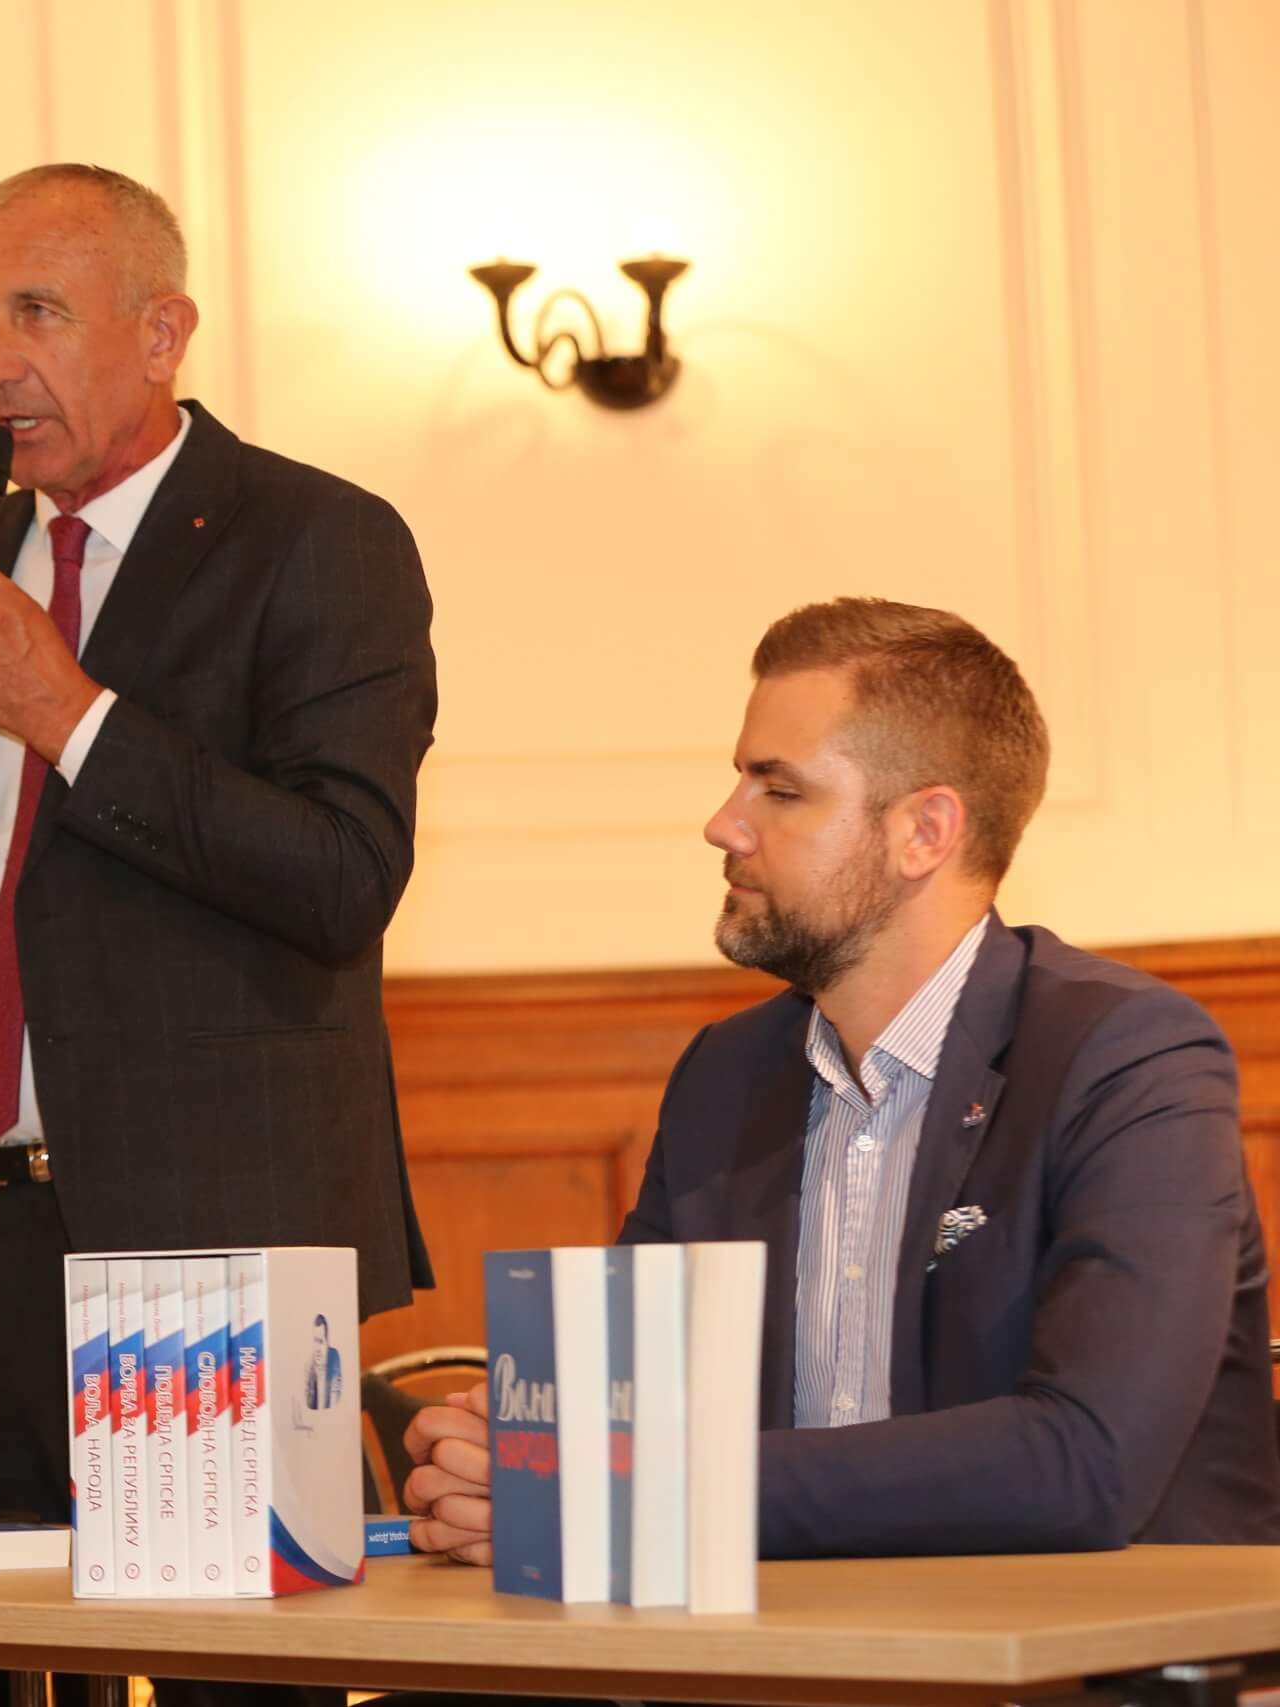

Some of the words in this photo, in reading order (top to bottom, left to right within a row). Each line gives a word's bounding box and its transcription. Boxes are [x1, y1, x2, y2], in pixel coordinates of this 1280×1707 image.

[82, 1373, 102, 1428] ВОЉА
[118, 1353, 138, 1414] БОРБА
[154, 1365, 174, 1447] ПОБЈЕДА
[197, 1351, 218, 1454] СЛОБОДНА
[239, 1346, 258, 1443] НАПРИЈЕД
[121, 1416, 137, 1440] ЗА
[87, 1437, 103, 1513] НАРОДА
[122, 1444, 139, 1548] РЕПУБЛИКУ
[158, 1451, 175, 1521] СРПСКЕ
[202, 1458, 219, 1531] СРПСКА
[242, 1446, 259, 1518] СРПСКА
